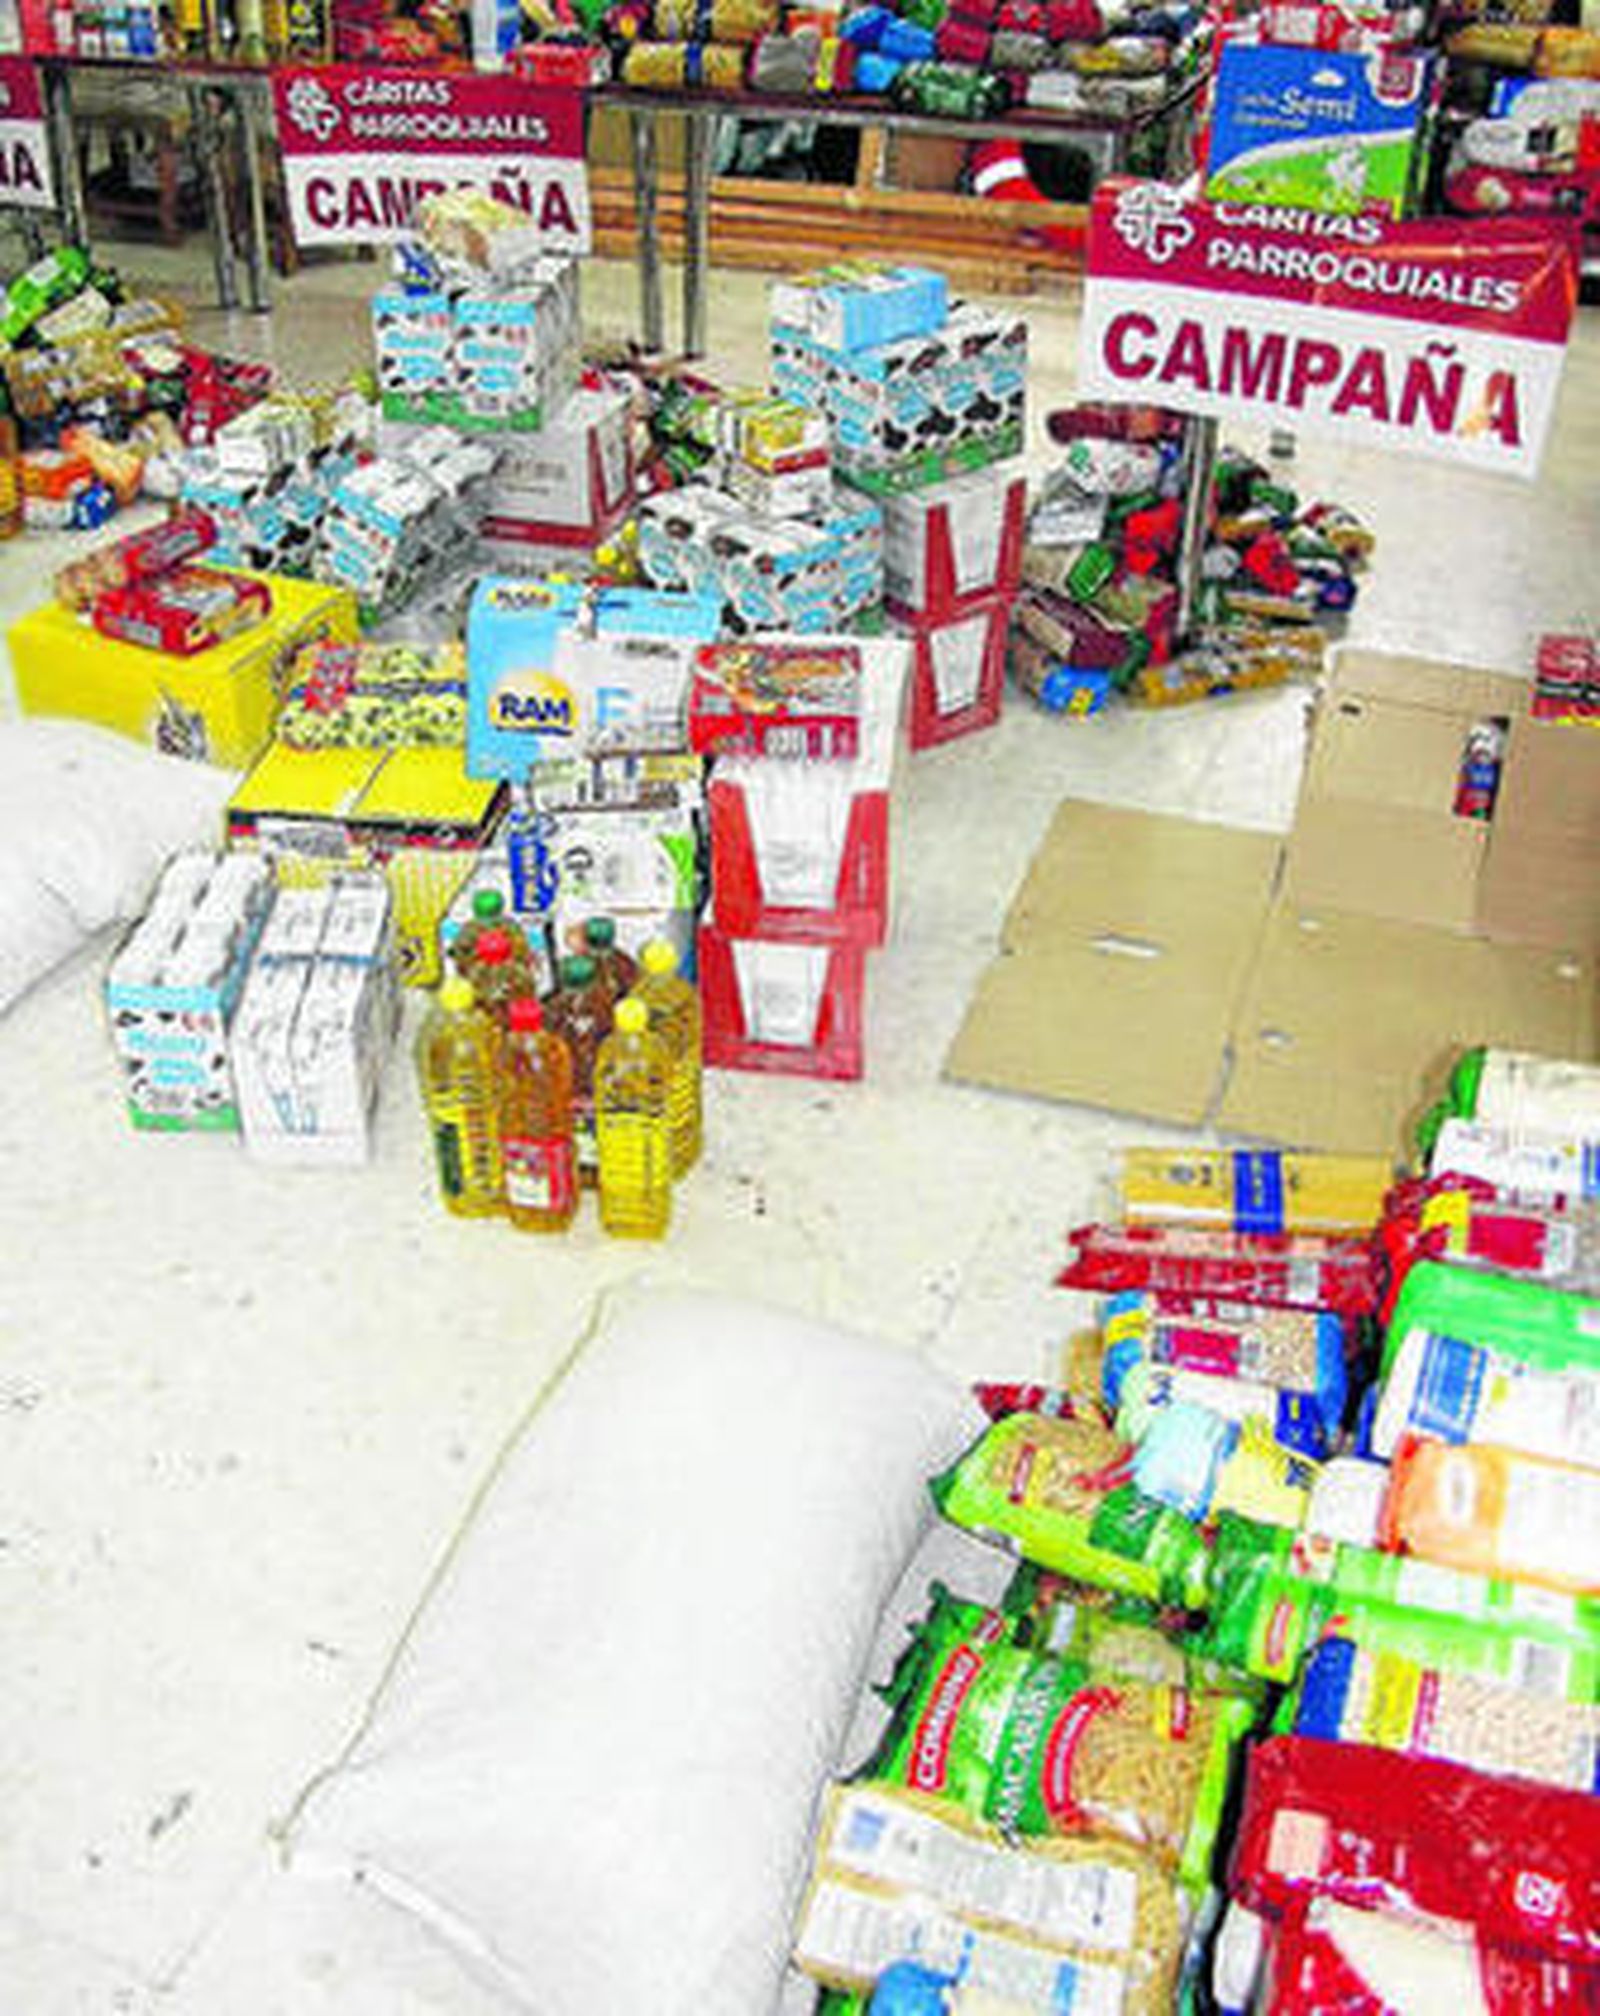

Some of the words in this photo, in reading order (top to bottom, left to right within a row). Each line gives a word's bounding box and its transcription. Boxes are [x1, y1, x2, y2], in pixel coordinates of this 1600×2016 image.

[350, 112, 548, 141] PARROQUIALES
[304, 164, 579, 236] CAMÑA
[1206, 237, 1523, 311] PARROQUIALES
[1102, 311, 1523, 446] CAMPAÑA
[499, 690, 572, 725] RAM
